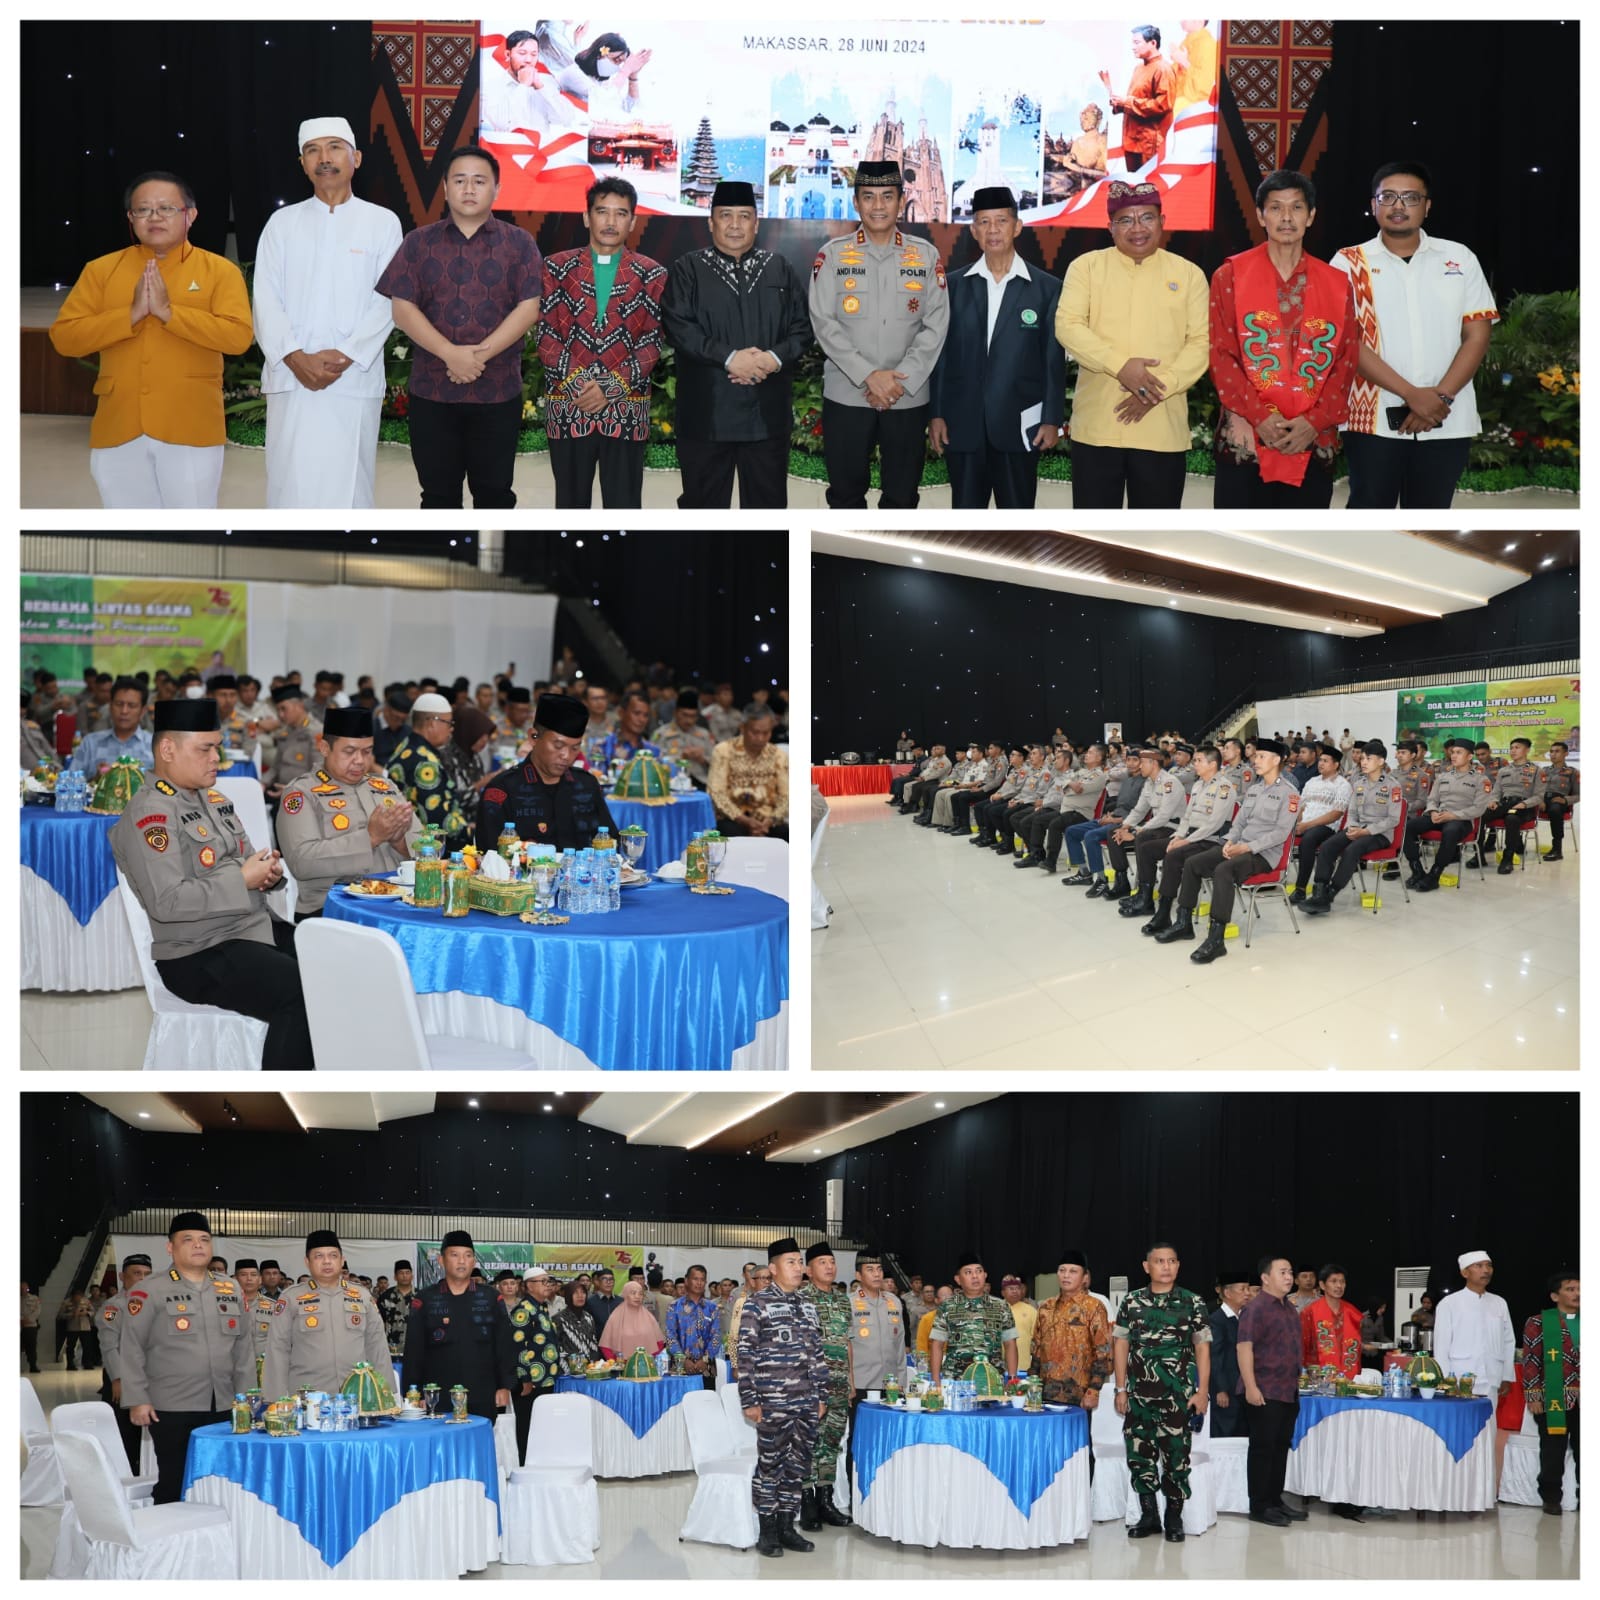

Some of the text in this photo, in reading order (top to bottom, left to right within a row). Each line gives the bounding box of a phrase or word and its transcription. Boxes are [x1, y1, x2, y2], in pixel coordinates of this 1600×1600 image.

[743, 36, 926, 53] MAKASSAR, 28 JUNI 2024
[836, 268, 850, 276] ANDI
[900, 269, 926, 278] POLRI
[23, 600, 89, 614] BERSAMA
[93, 602, 142, 617] LINTAS
[145, 603, 193, 618] AGAMA
[1444, 700, 1484, 710] BERSAMA
[1486, 697, 1518, 708] LINTAS
[1521, 695, 1557, 706] AGAMA
[570, 1263, 604, 1272] AGAMA
[165, 1294, 192, 1303] ARIS
[216, 1295, 238, 1303] POLRI
